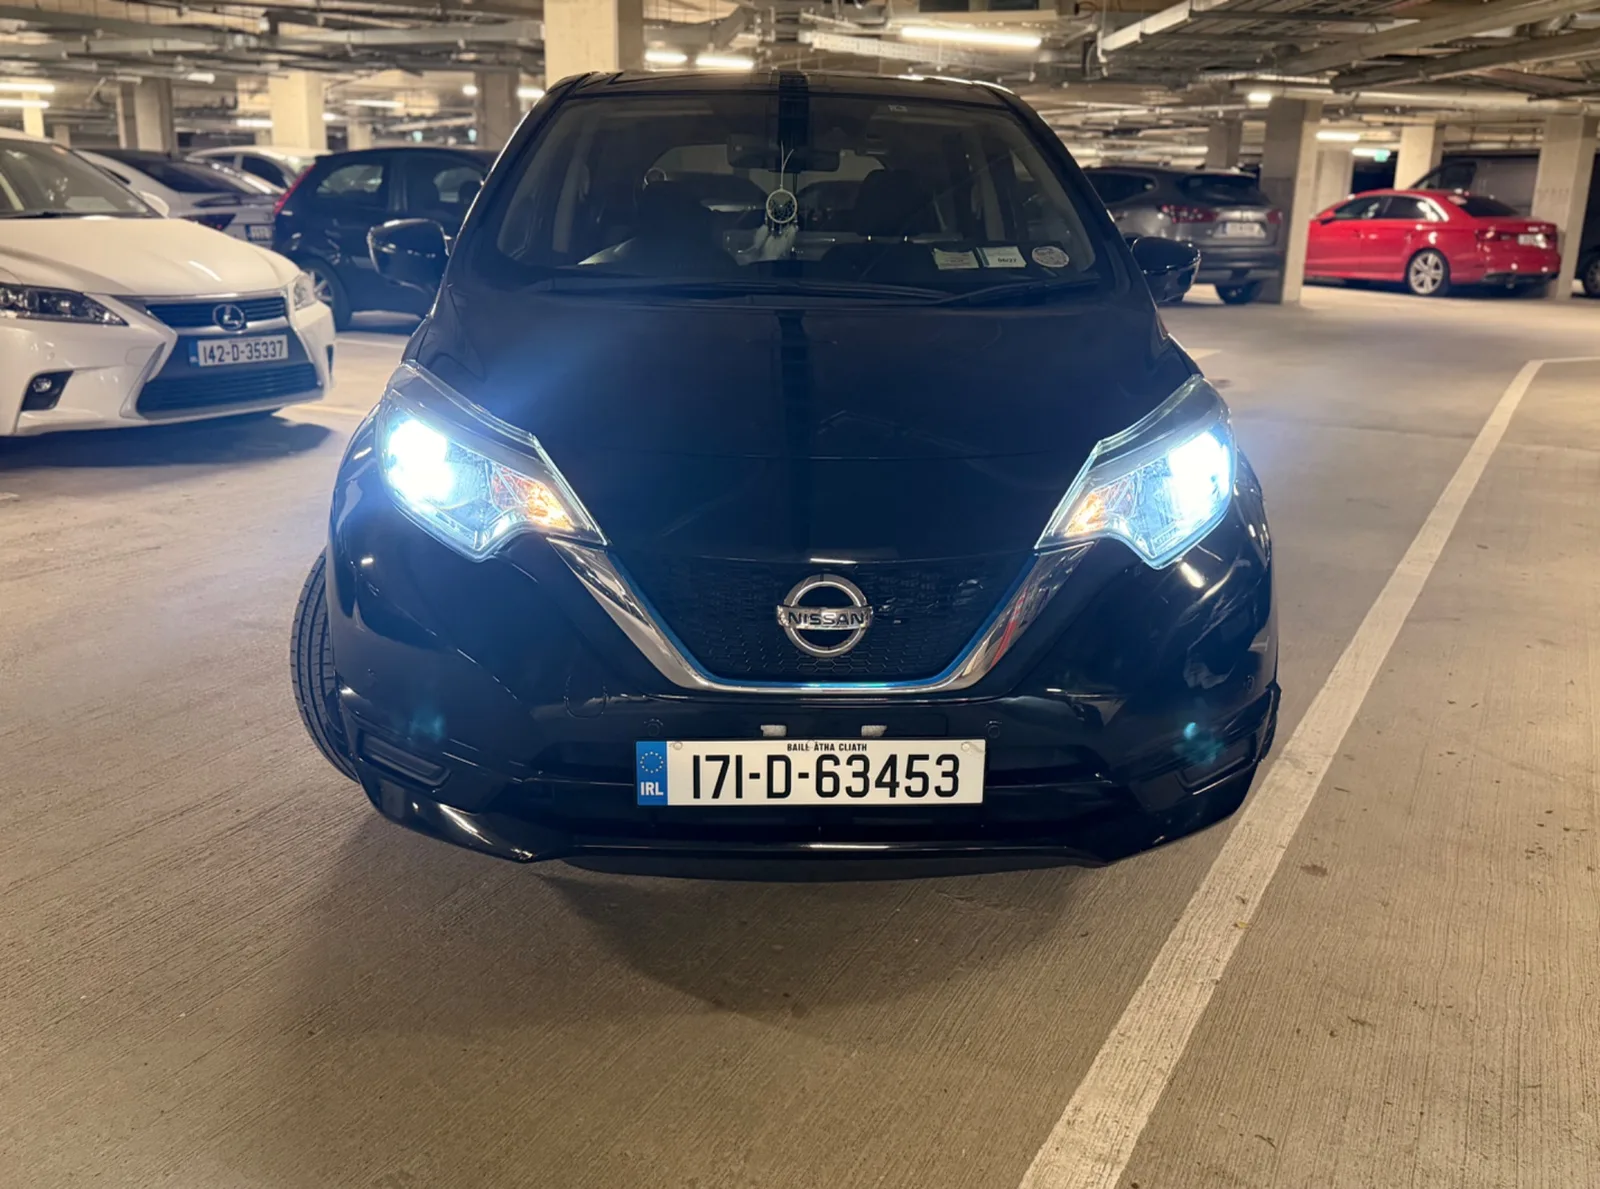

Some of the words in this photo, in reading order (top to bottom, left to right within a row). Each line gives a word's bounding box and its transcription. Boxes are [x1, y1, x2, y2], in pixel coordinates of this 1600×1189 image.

[203, 340, 284, 363] 142-D-35337
[788, 612, 864, 625] NISSAN
[787, 743, 810, 751] BAILE
[838, 743, 867, 751] CLIATH
[692, 754, 959, 799] 171-D-63453
[640, 781, 664, 796] IRL
